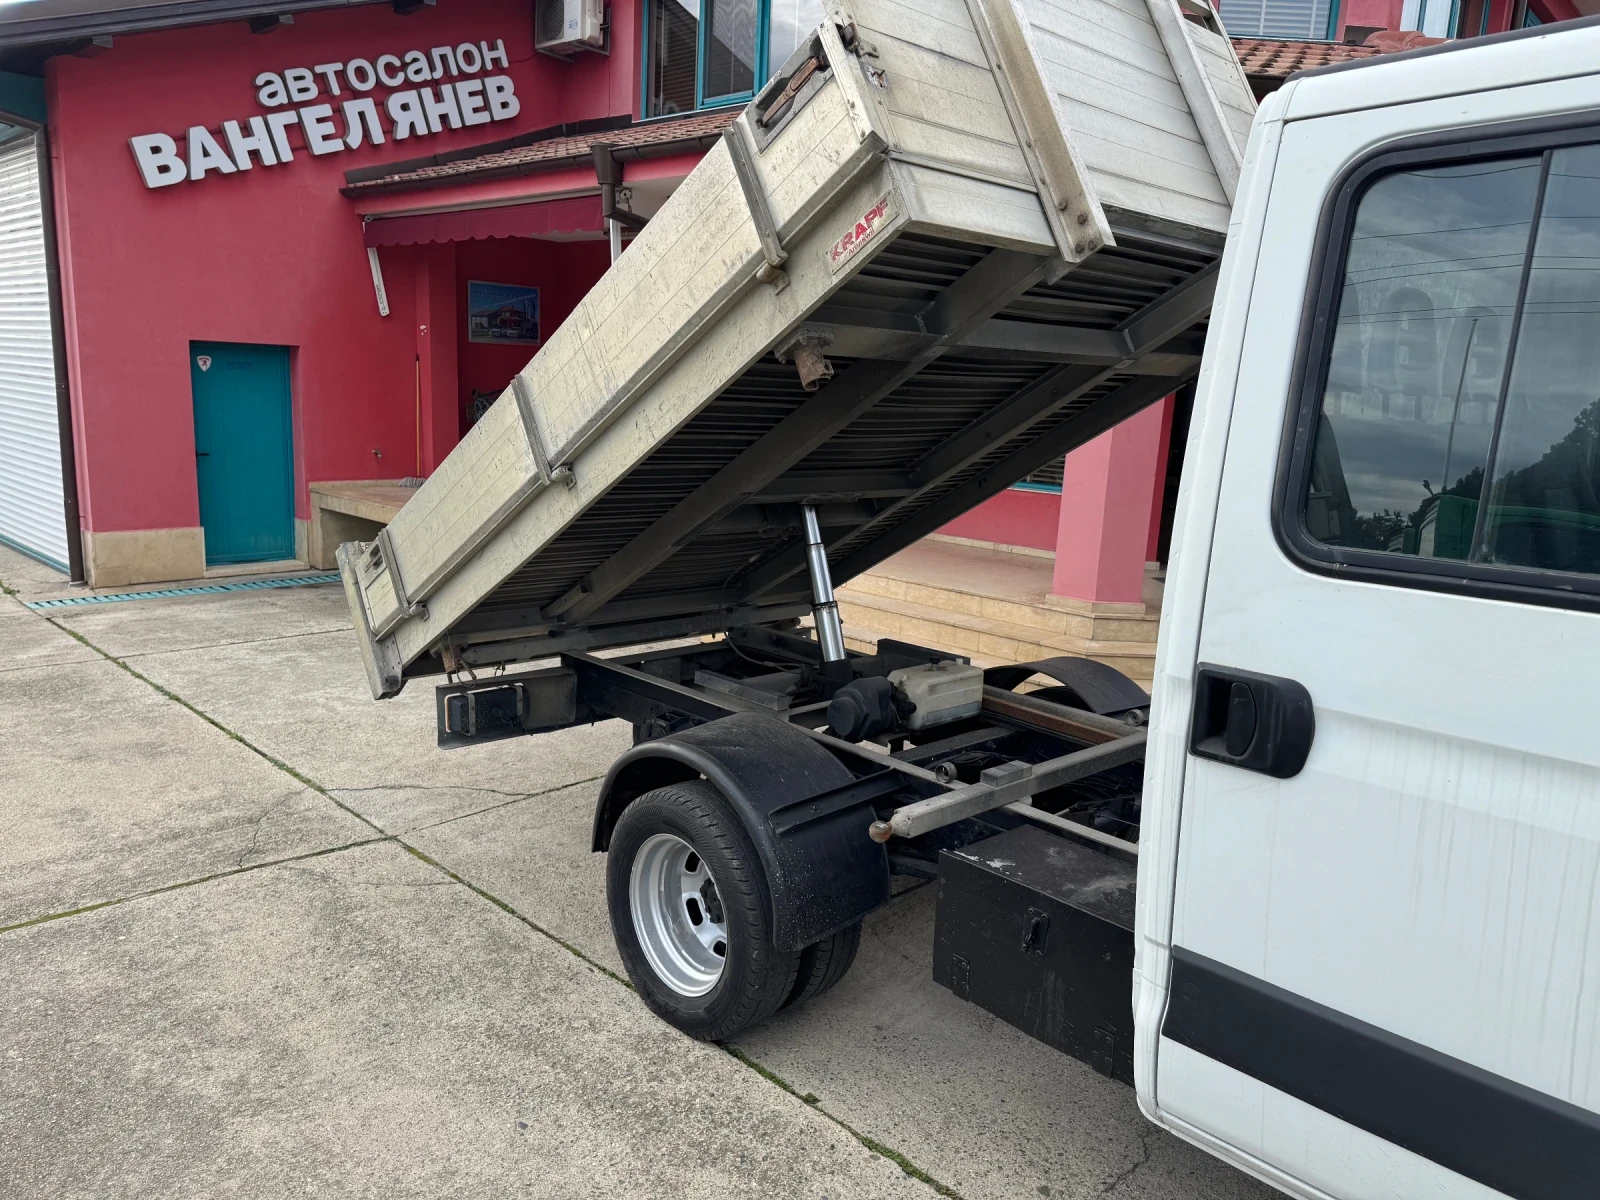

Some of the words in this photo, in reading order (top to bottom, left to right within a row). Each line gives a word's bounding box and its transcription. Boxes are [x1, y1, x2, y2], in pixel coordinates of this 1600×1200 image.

[254, 39, 509, 107] автосалон
[128, 98, 386, 189] ВАНГЕЛ
[387, 75, 521, 141] ЯНЕВ
[830, 198, 889, 262] KRAPF
